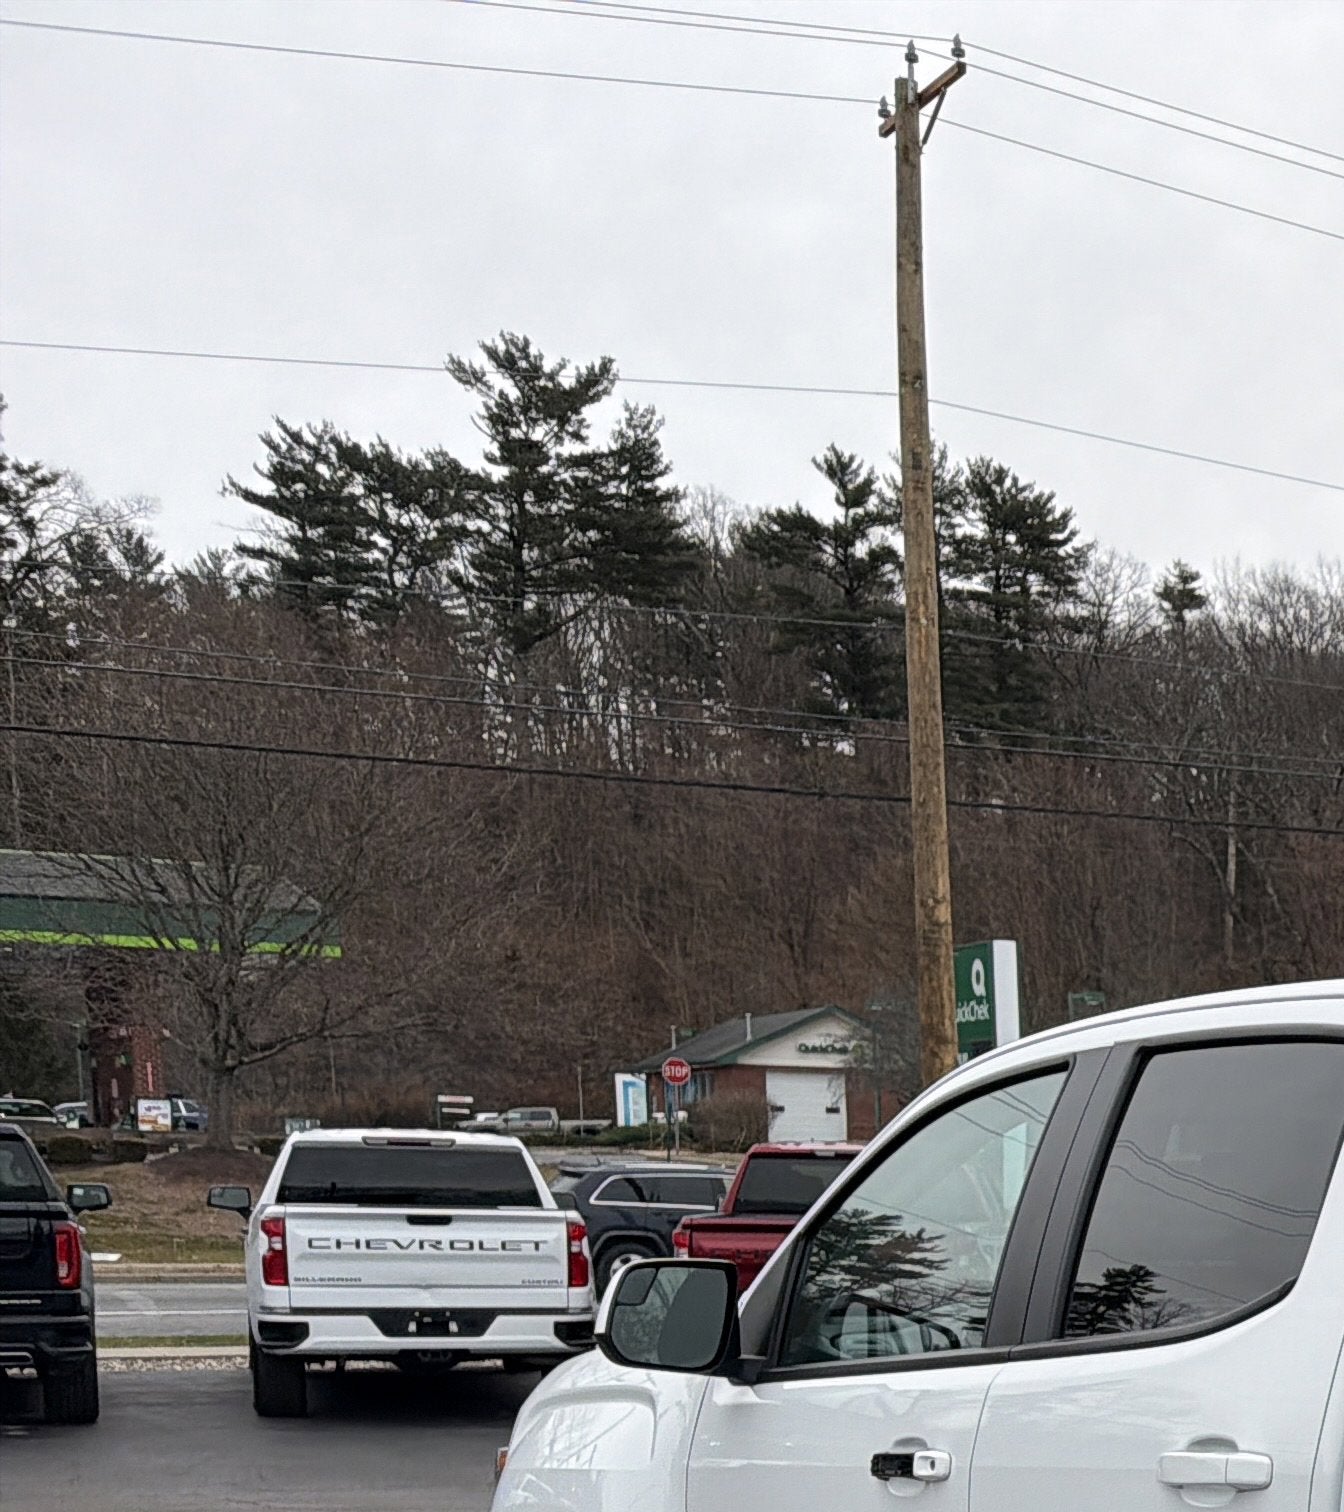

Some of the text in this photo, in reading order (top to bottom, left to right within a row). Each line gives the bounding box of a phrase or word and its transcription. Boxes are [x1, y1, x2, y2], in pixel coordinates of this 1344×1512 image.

[955, 999, 990, 1023] uickChek
[664, 1064, 688, 1078] STOP
[307, 1237, 548, 1252] CHEVROLET
